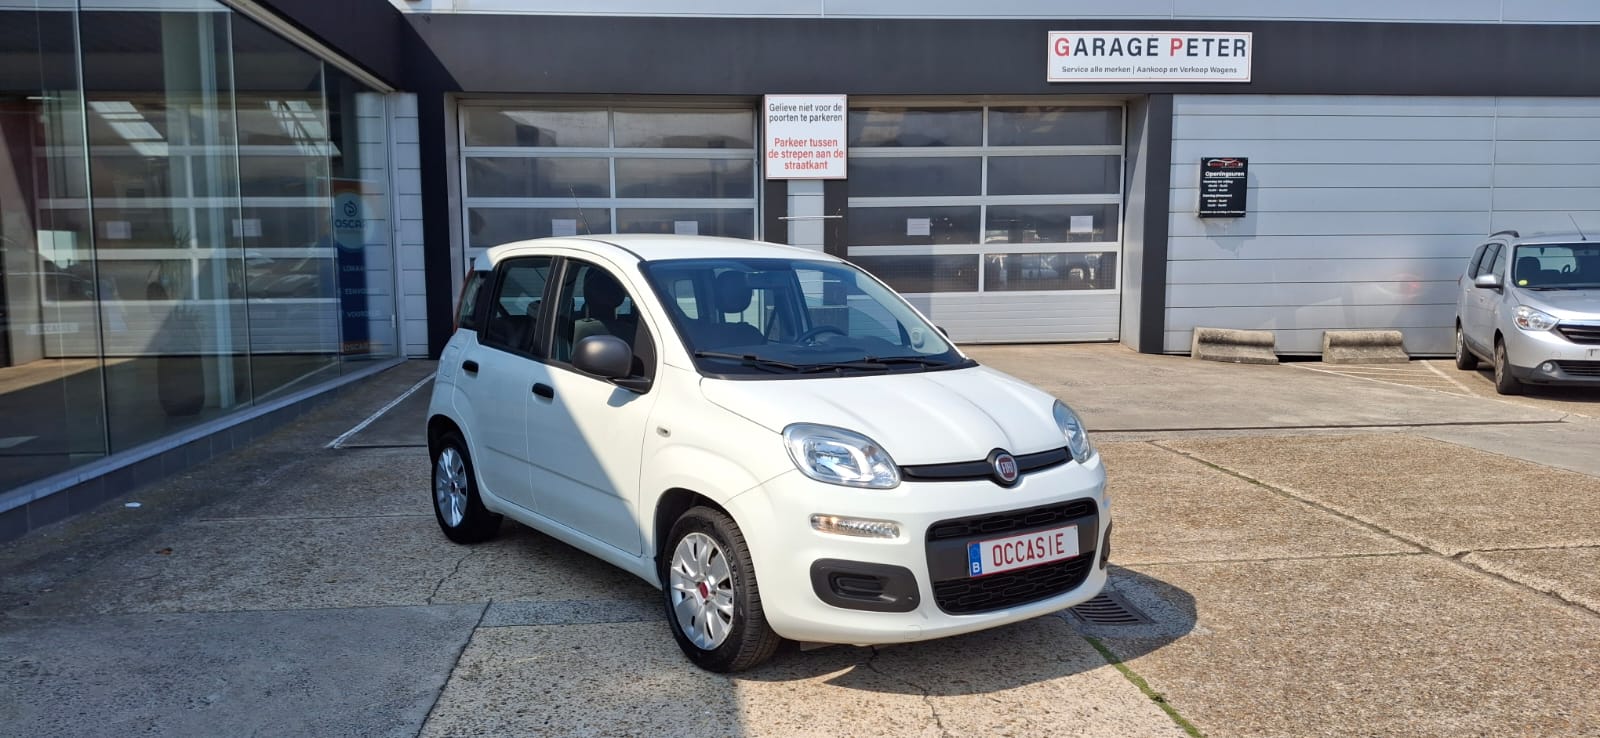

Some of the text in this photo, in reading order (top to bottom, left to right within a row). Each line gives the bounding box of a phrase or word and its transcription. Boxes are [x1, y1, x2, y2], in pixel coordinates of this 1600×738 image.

[1054, 37, 1246, 57] GARAGE PETER
[1136, 66, 1168, 75] Aankoop
[1180, 66, 1209, 75] Verkoop
[1210, 67, 1237, 75] Wagens
[769, 103, 797, 112] Gelieve
[798, 103, 813, 112] niet
[833, 103, 843, 112] de
[769, 113, 843, 124] poorten te parkeren
[774, 137, 838, 147] Parkeer tussen
[768, 148, 844, 161] de strepen aan de
[784, 160, 828, 170] straatkant
[1000, 461, 1014, 474] FIAT
[972, 533, 1065, 573] OCCASIE B
